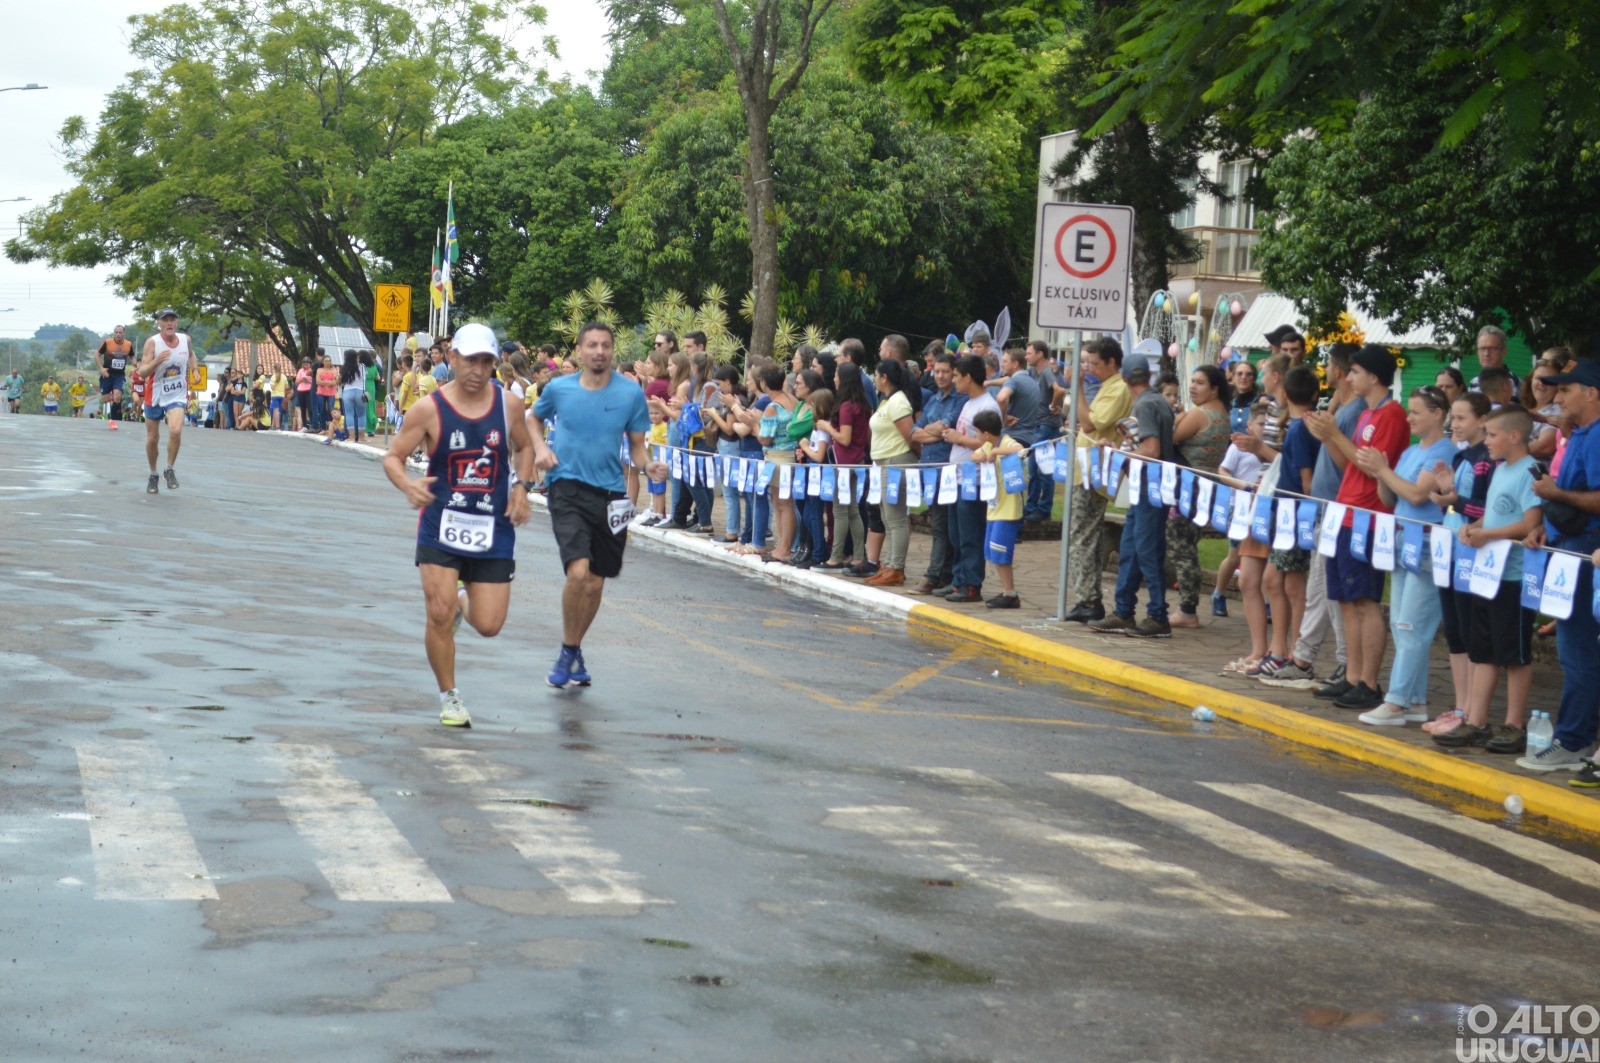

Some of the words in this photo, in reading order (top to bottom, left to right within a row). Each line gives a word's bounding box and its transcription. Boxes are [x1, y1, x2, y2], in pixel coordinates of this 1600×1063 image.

[1075, 229, 1096, 263] E
[1045, 285, 1120, 302] EXCLUSIVO
[1067, 301, 1097, 319] TÁXI
[163, 381, 182, 393] 644
[455, 457, 491, 478] TAG
[457, 477, 488, 485] TARCISO
[444, 526, 487, 549] 662
[1473, 566, 1500, 582] Banrisul
[1544, 585, 1572, 600] Banrisul
